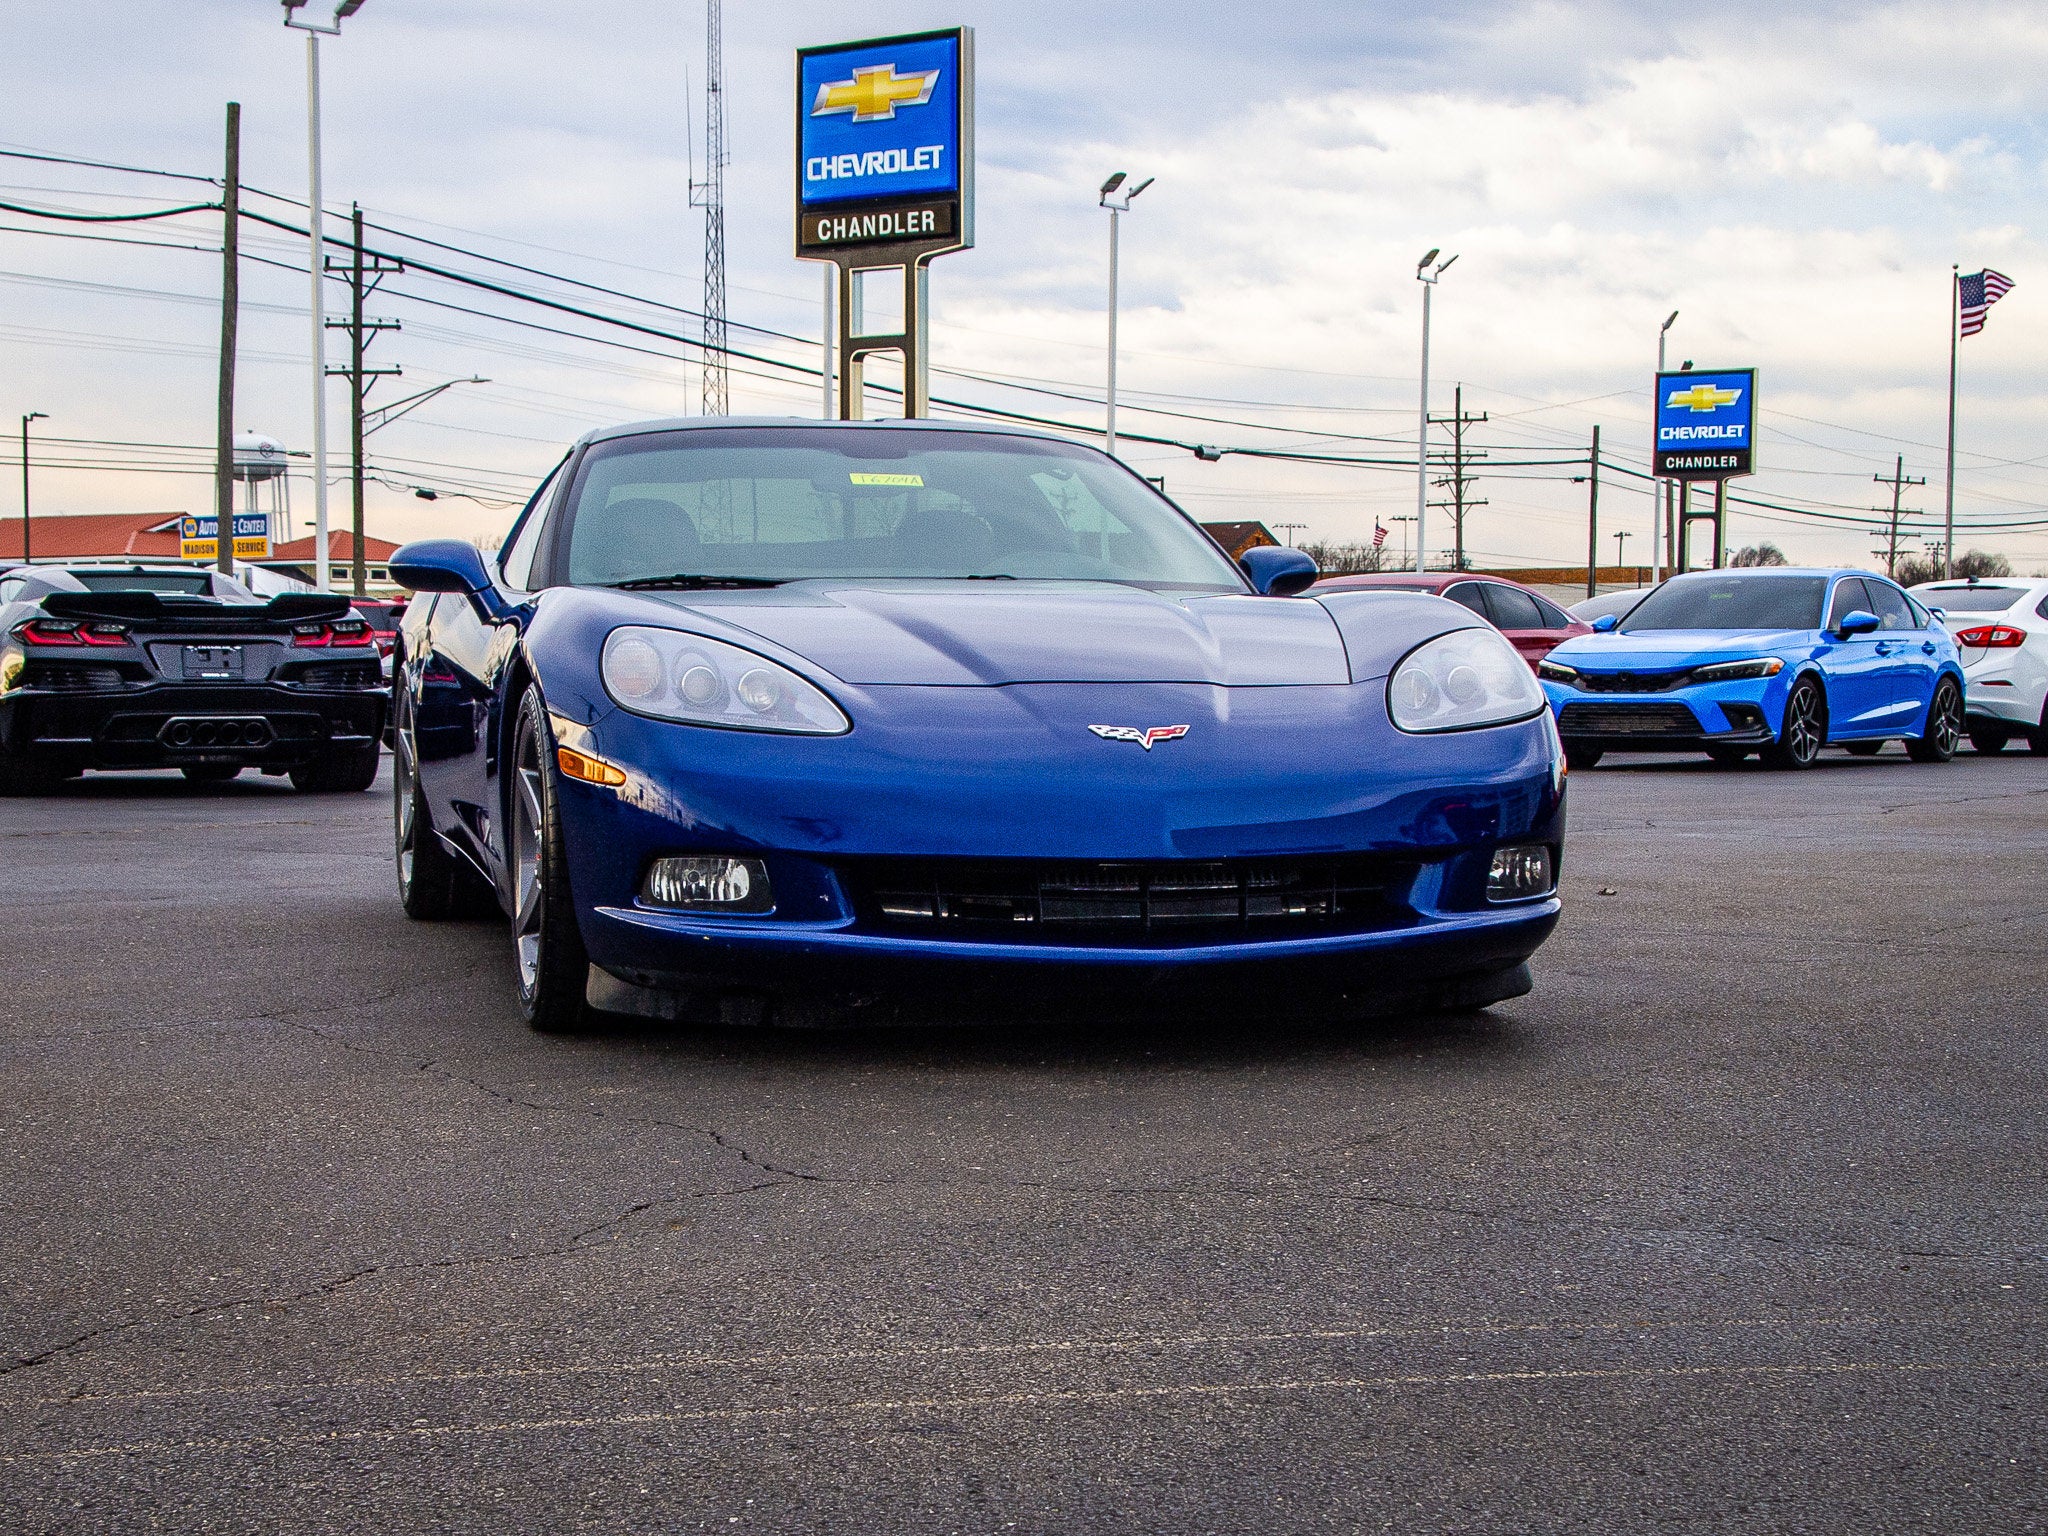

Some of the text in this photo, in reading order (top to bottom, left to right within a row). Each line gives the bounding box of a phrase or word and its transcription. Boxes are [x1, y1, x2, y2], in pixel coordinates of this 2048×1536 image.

[806, 145, 944, 181] CHEVROLET
[817, 210, 935, 241] CHANDLER
[1660, 425, 1746, 440] CHEVROLET
[1666, 456, 1738, 469] CHANDLER
[238, 518, 265, 533] CENTER
[184, 544, 215, 555] MADISON
[237, 542, 265, 553] SERVICE
